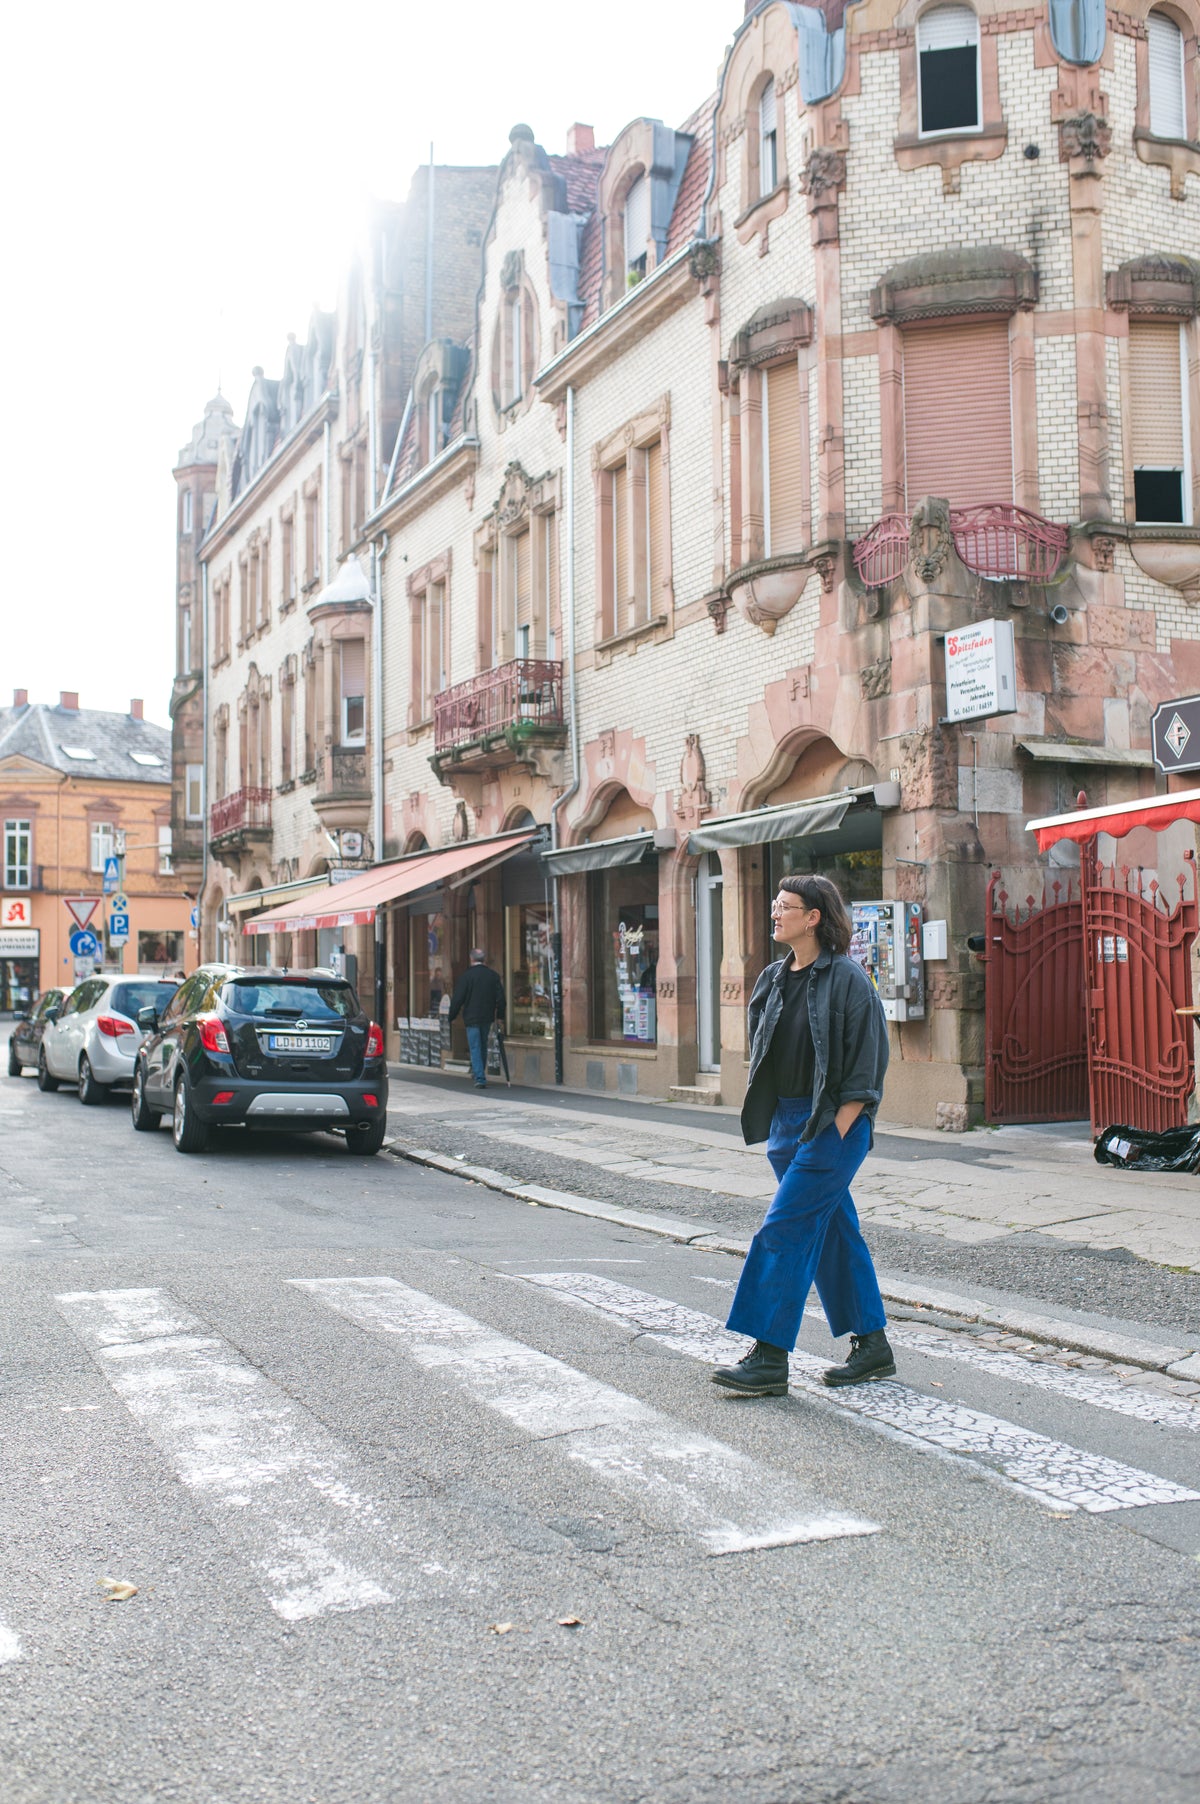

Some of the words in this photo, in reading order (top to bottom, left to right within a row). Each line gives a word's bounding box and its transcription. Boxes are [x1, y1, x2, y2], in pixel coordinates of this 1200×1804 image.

[947, 635, 993, 656] Spitzfaden
[114, 916, 125, 933] P
[276, 1037, 290, 1047] LD
[305, 1038, 329, 1049] 1102
